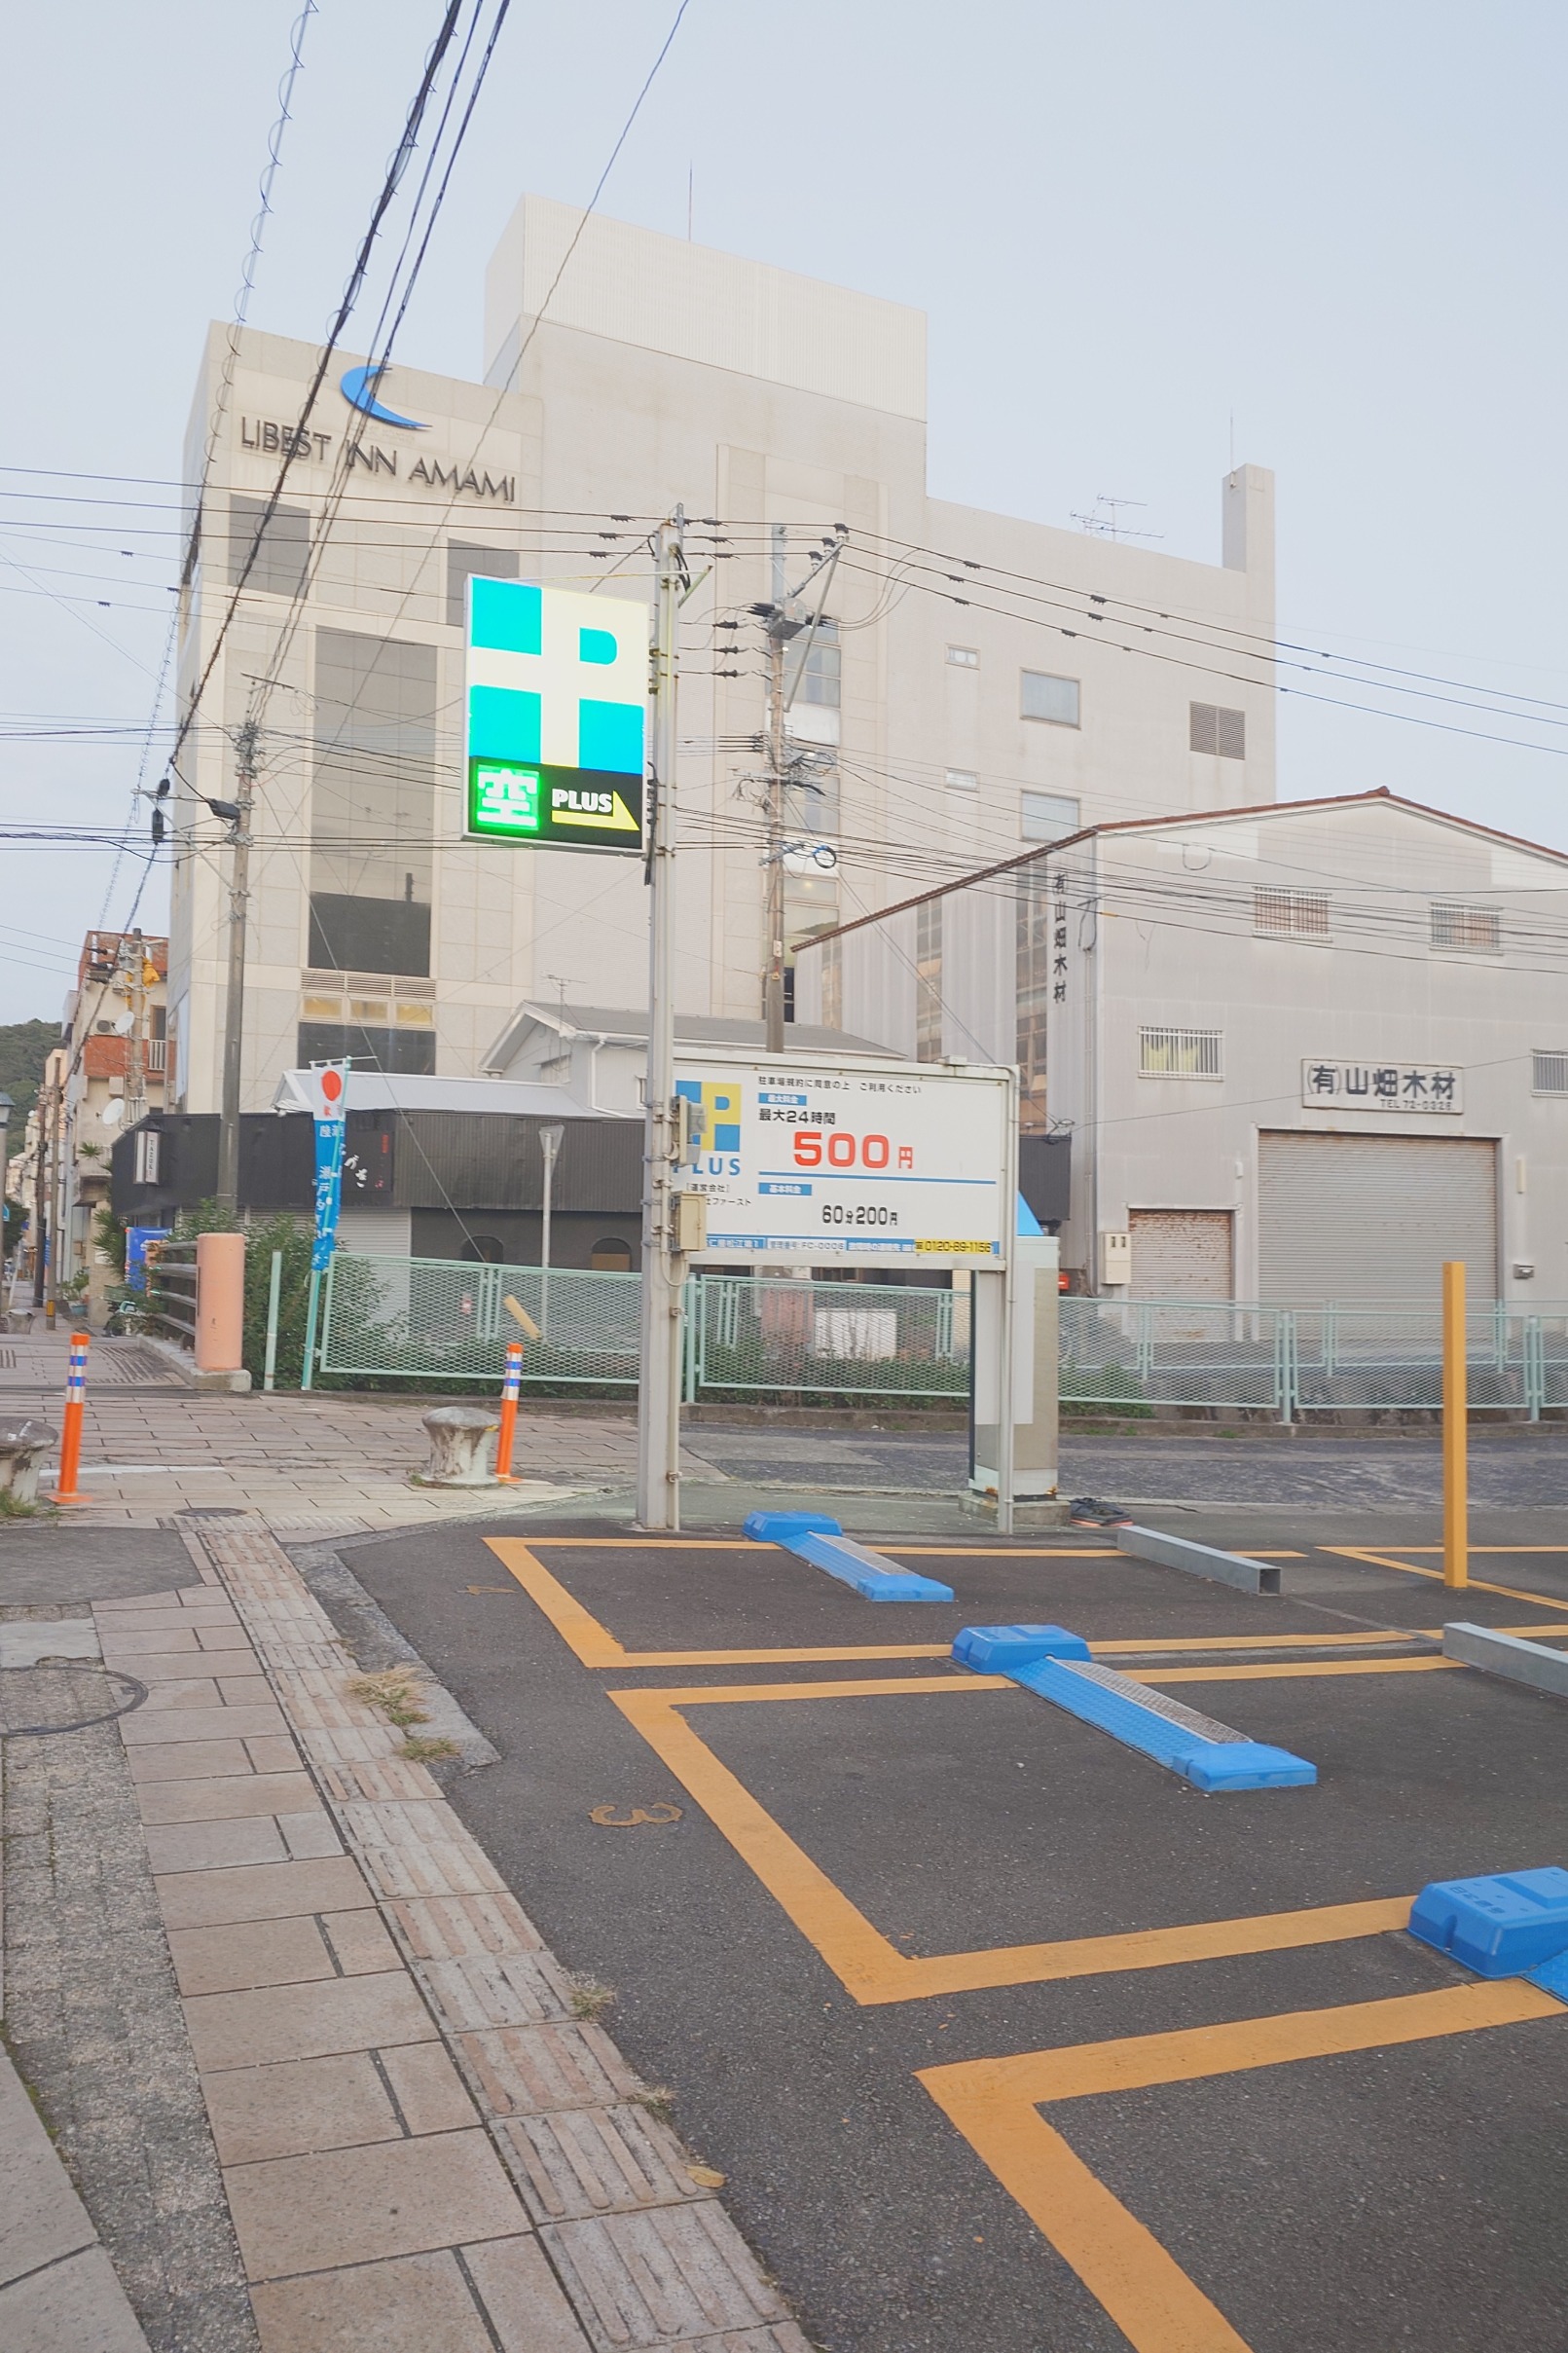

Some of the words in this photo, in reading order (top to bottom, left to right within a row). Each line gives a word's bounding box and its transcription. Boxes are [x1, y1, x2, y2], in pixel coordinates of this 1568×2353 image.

[241, 416, 332, 461] LIBEST
[345, 439, 397, 477] INN
[408, 457, 516, 504] AMAMI
[476, 767, 539, 827] 空
[551, 788, 614, 813] PLUS
[1380, 1098, 1401, 1109] TEL
[759, 1108, 836, 1125] 最大24時間
